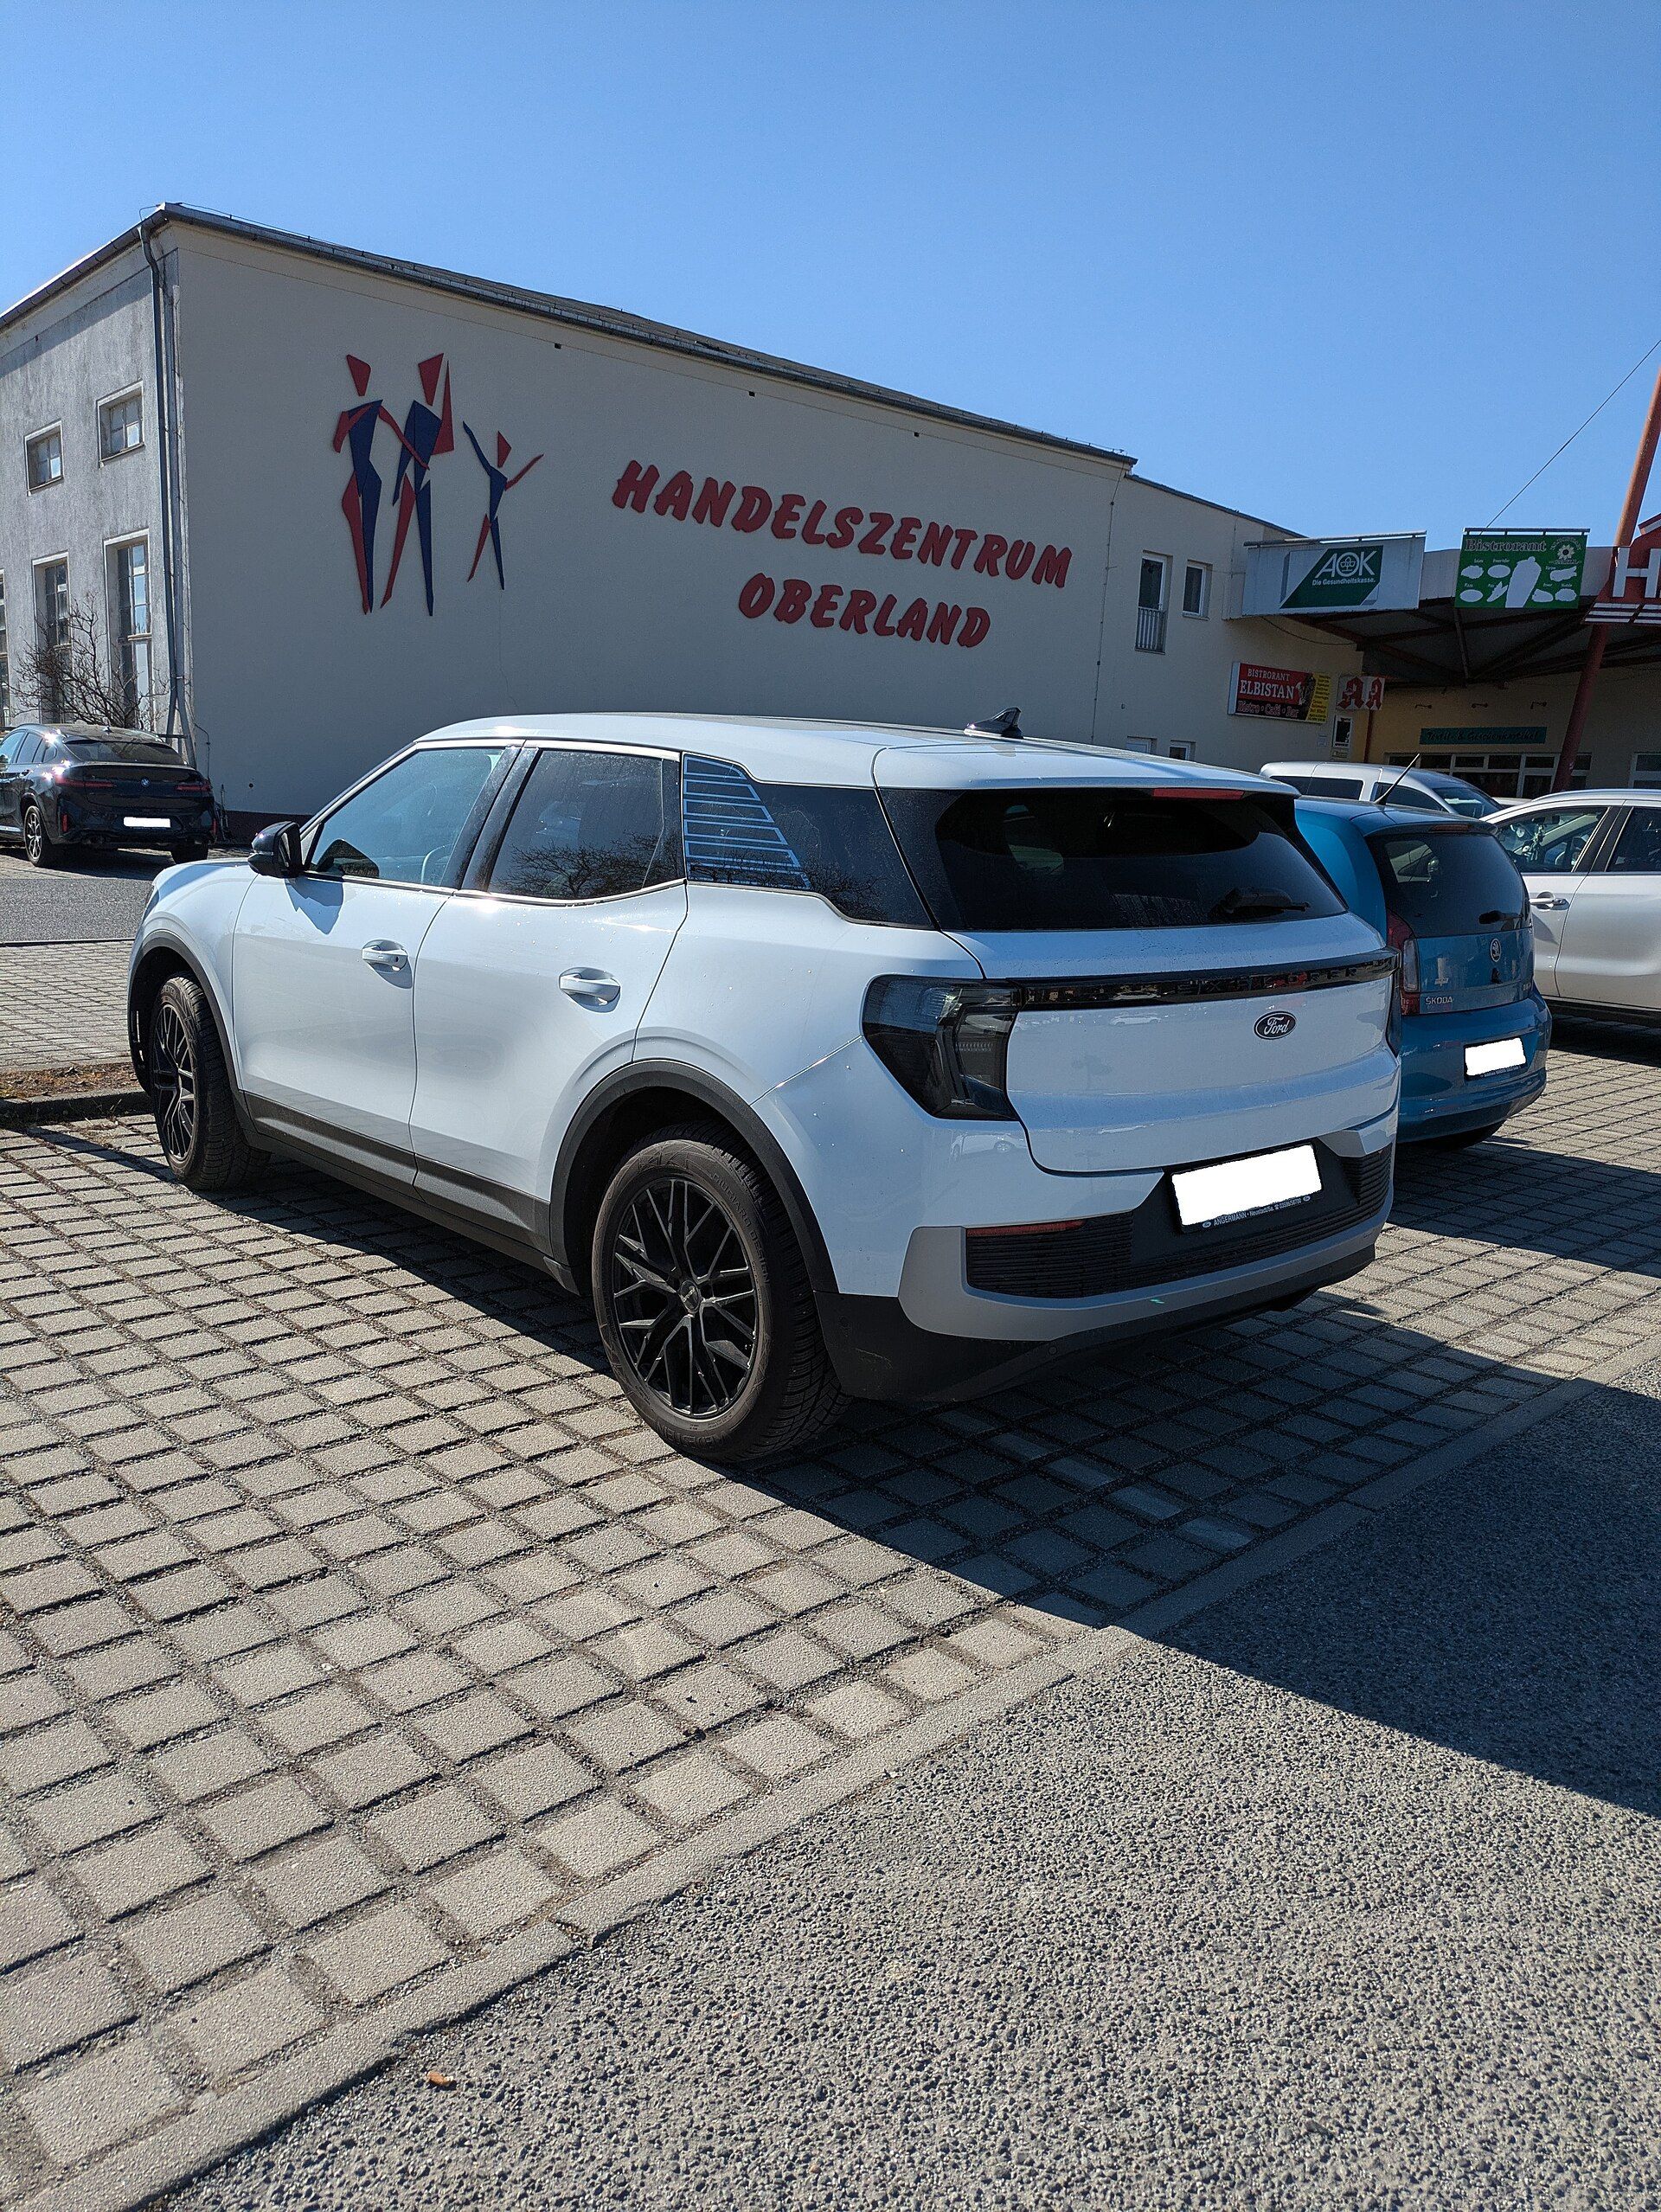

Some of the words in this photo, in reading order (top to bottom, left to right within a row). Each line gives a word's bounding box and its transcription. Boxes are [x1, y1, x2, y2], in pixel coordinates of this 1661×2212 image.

[612, 459, 1073, 588] HANDELSZENTRUM
[1464, 538, 1547, 552] Bistrorant
[1315, 550, 1377, 579] AOK
[1612, 547, 1661, 599] H
[1322, 577, 1376, 586] Gesundheitskasse.
[738, 572, 991, 648] OBERLAND
[1247, 668, 1291, 682] BISTRORANT
[1240, 679, 1295, 700] ELBISTAN
[1237, 700, 1260, 715] Bistro
[1265, 703, 1281, 716] Café
[1263, 1016, 1291, 1035] Ford
[1214, 1211, 1247, 1227] ANGERMANN
